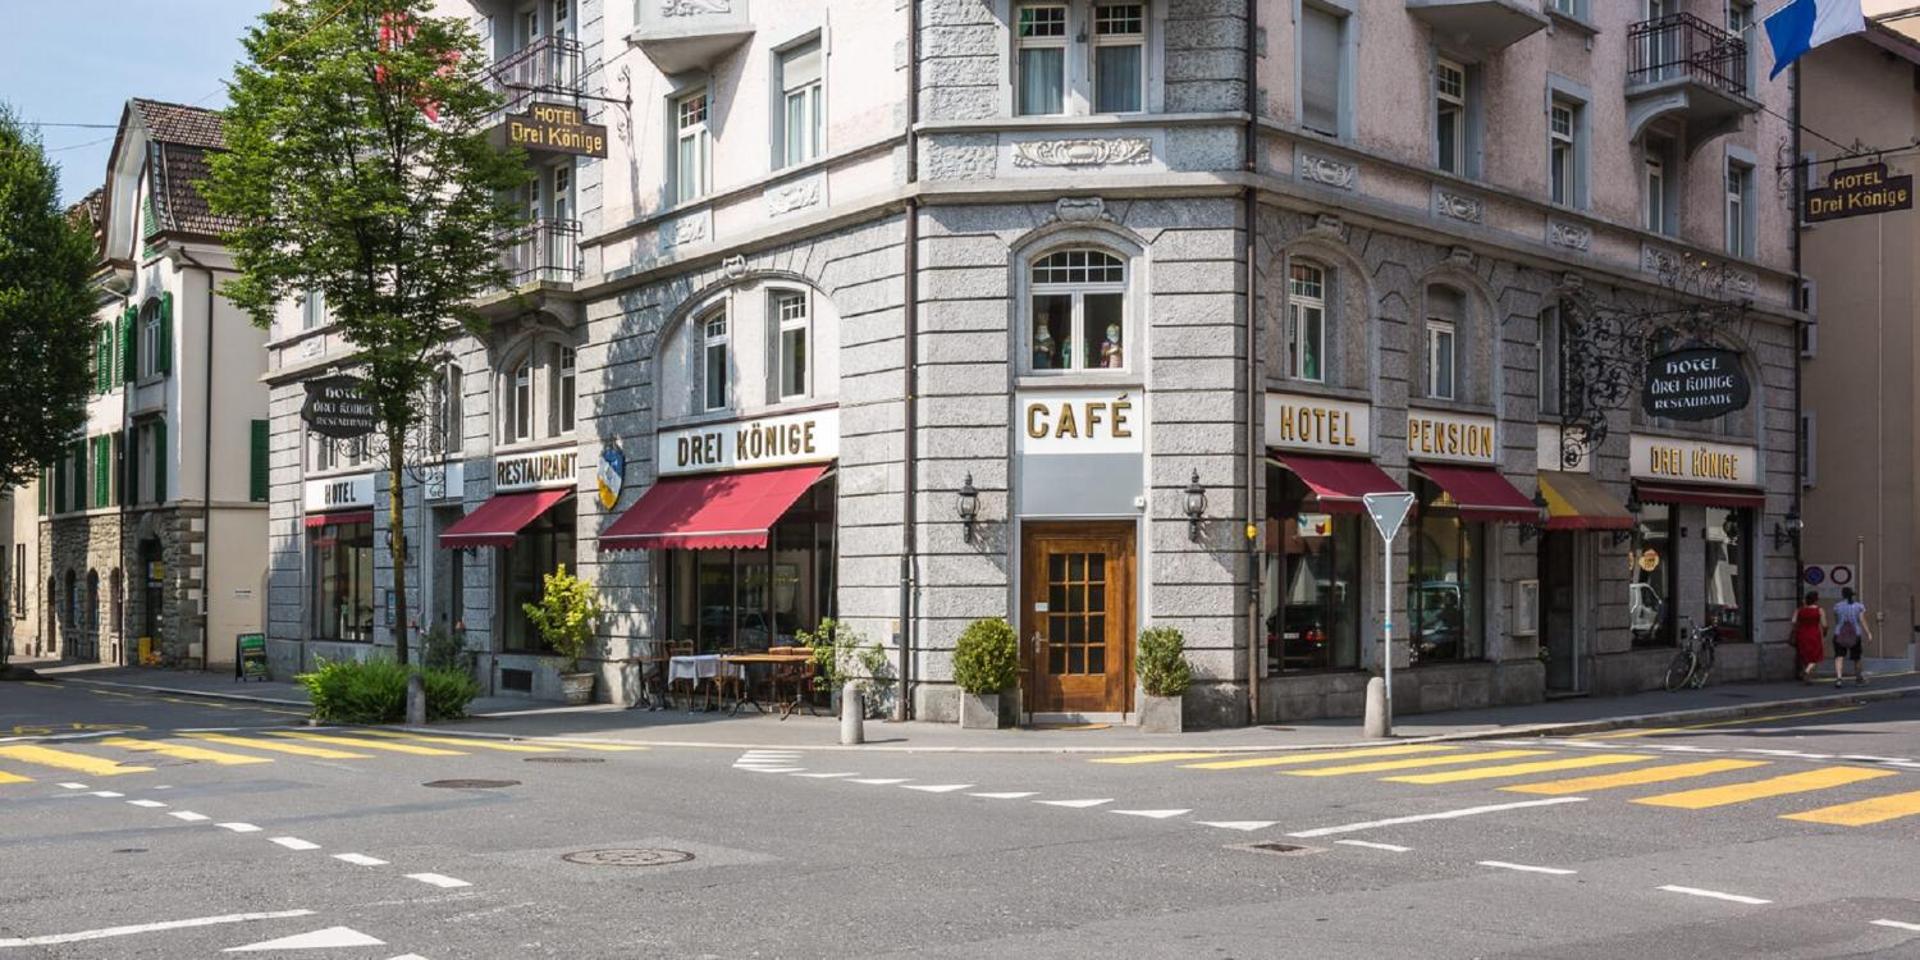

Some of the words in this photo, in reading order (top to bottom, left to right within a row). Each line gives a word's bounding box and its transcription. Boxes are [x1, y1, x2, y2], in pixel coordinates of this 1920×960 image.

[534, 106, 581, 126] HOTEL
[511, 122, 544, 143] Drei
[548, 127, 602, 153] Könige
[1834, 171, 1882, 190] HOTEL
[1810, 195, 1842, 214] Drei
[1848, 188, 1906, 209] Könige
[1027, 392, 1132, 438] CAFÉ
[1280, 405, 1356, 446] HOTEL
[677, 432, 723, 467] DREI
[736, 421, 816, 461] KÖNIGE
[1408, 418, 1493, 458] PENSION
[497, 453, 578, 486] RESTAURANT
[1650, 446, 1683, 476] DREI
[1692, 446, 1738, 481] KÖNIGE
[325, 481, 356, 505] HOTEL
